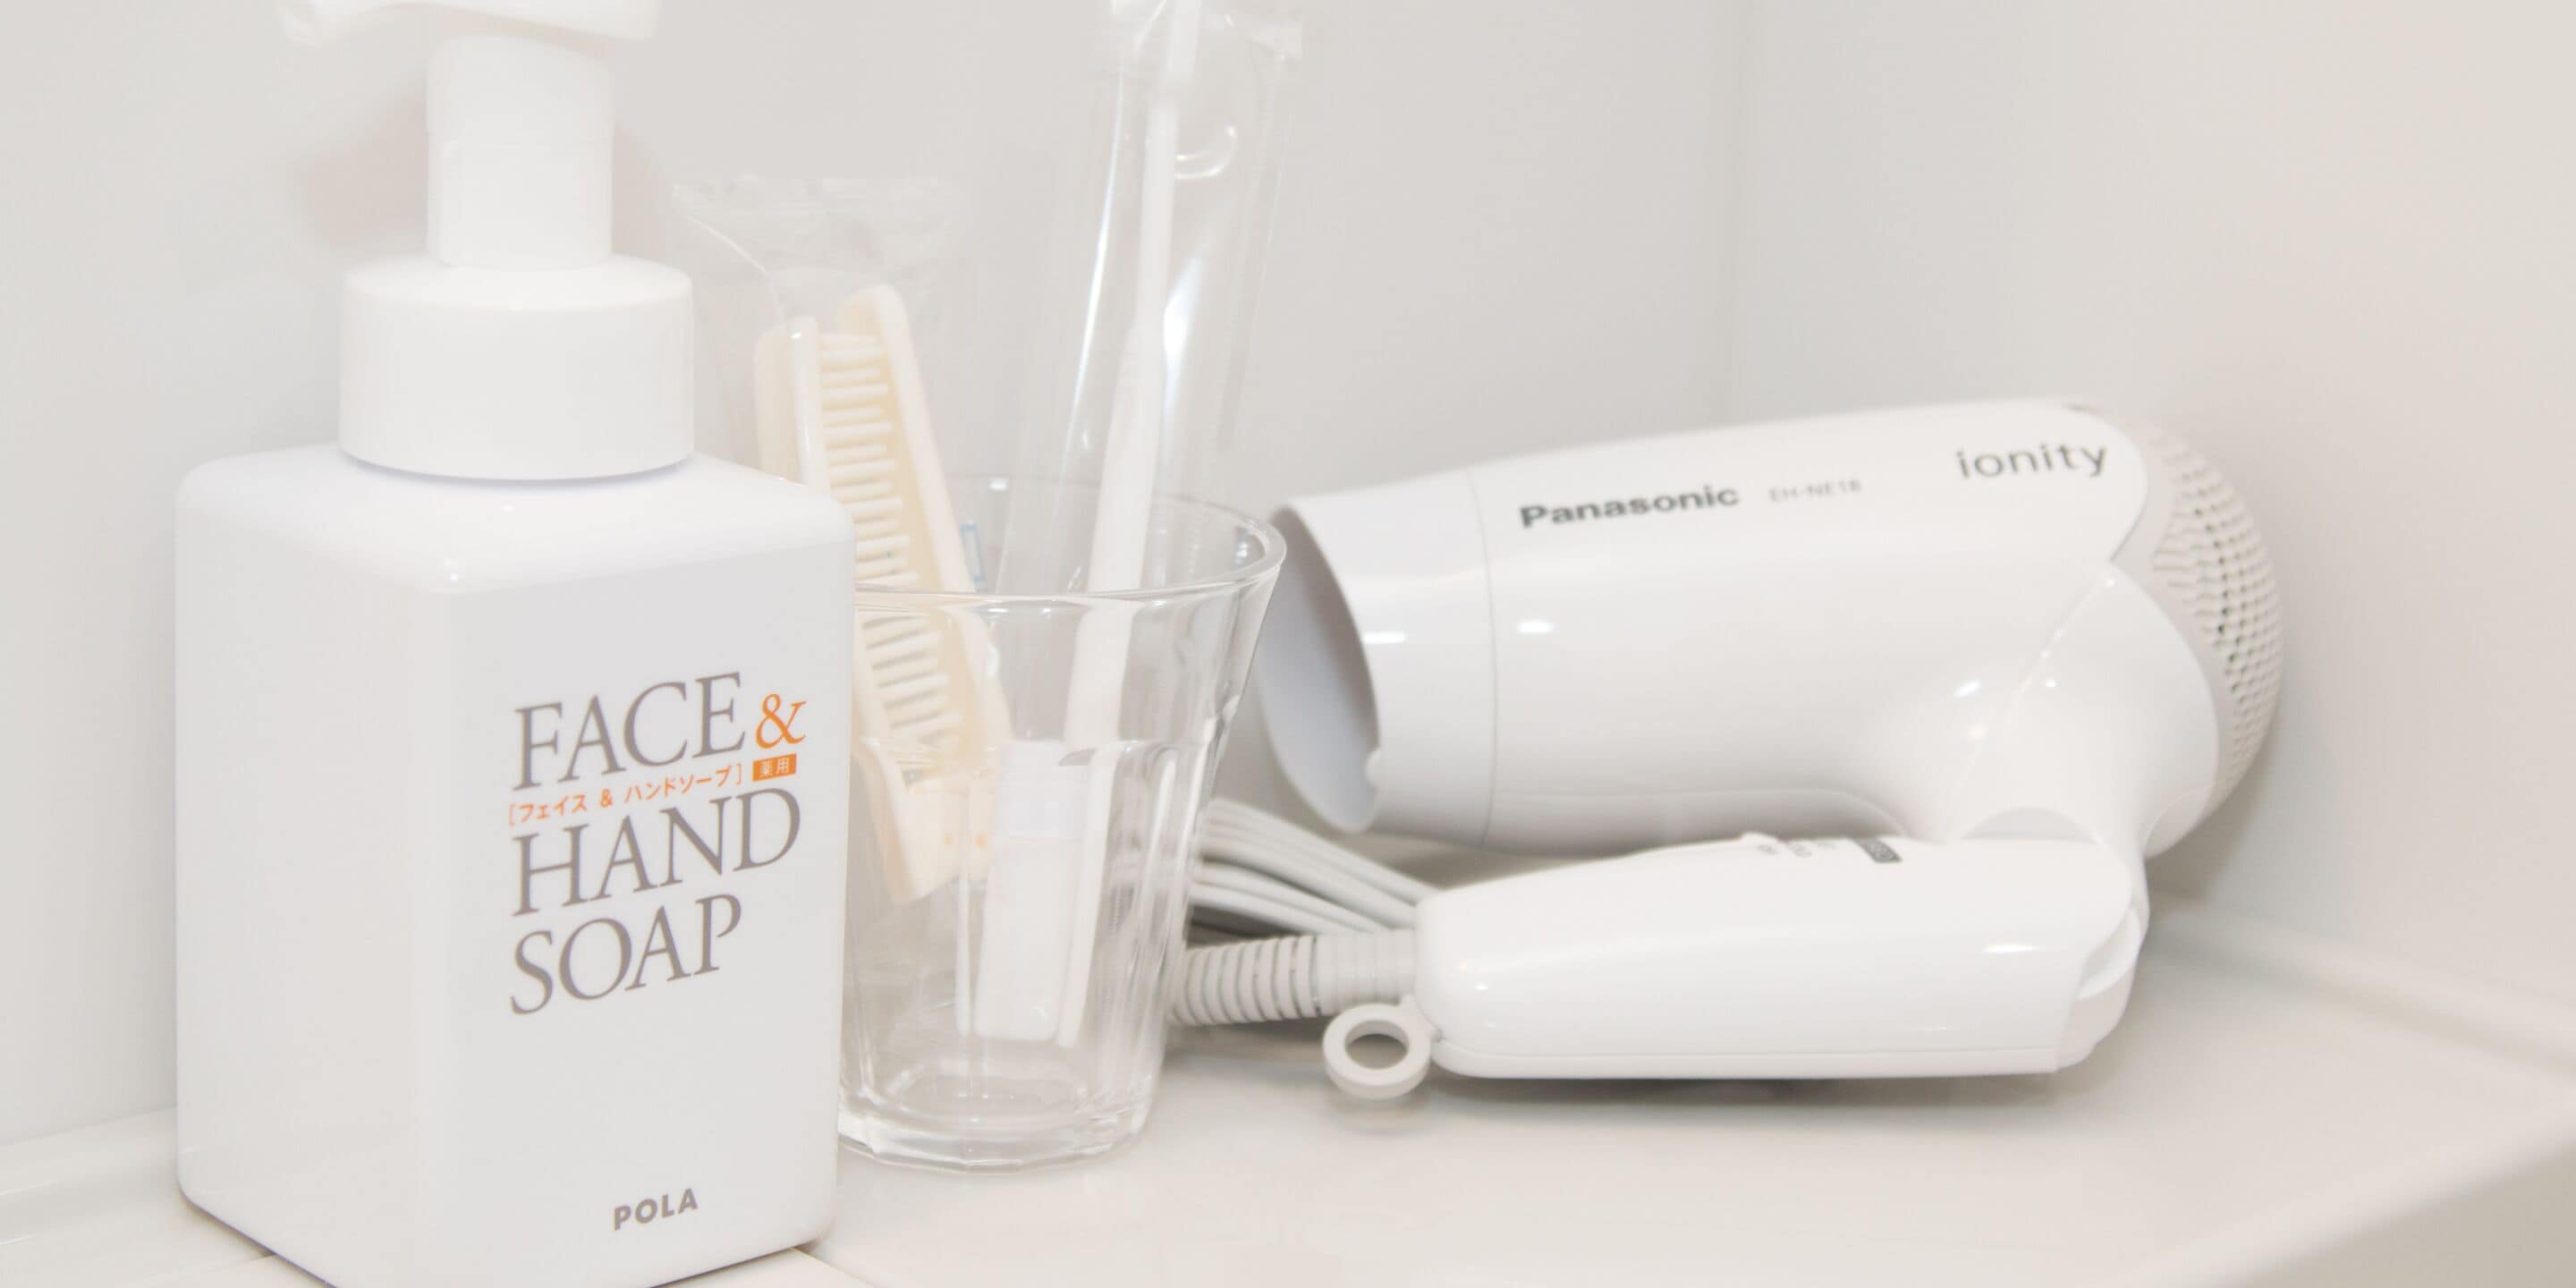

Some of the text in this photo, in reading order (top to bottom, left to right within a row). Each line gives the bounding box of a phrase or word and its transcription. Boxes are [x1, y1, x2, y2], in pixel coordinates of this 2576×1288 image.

[1956, 444, 2107, 479] ionity
[1520, 485, 1740, 528] Panasonic
[512, 672, 807, 791] FACE &
[759, 758, 790, 777] 薬用
[600, 789, 614, 808] &
[512, 788, 801, 917] HAND
[510, 894, 742, 1015] SOAP
[614, 1187, 699, 1232] POLA
